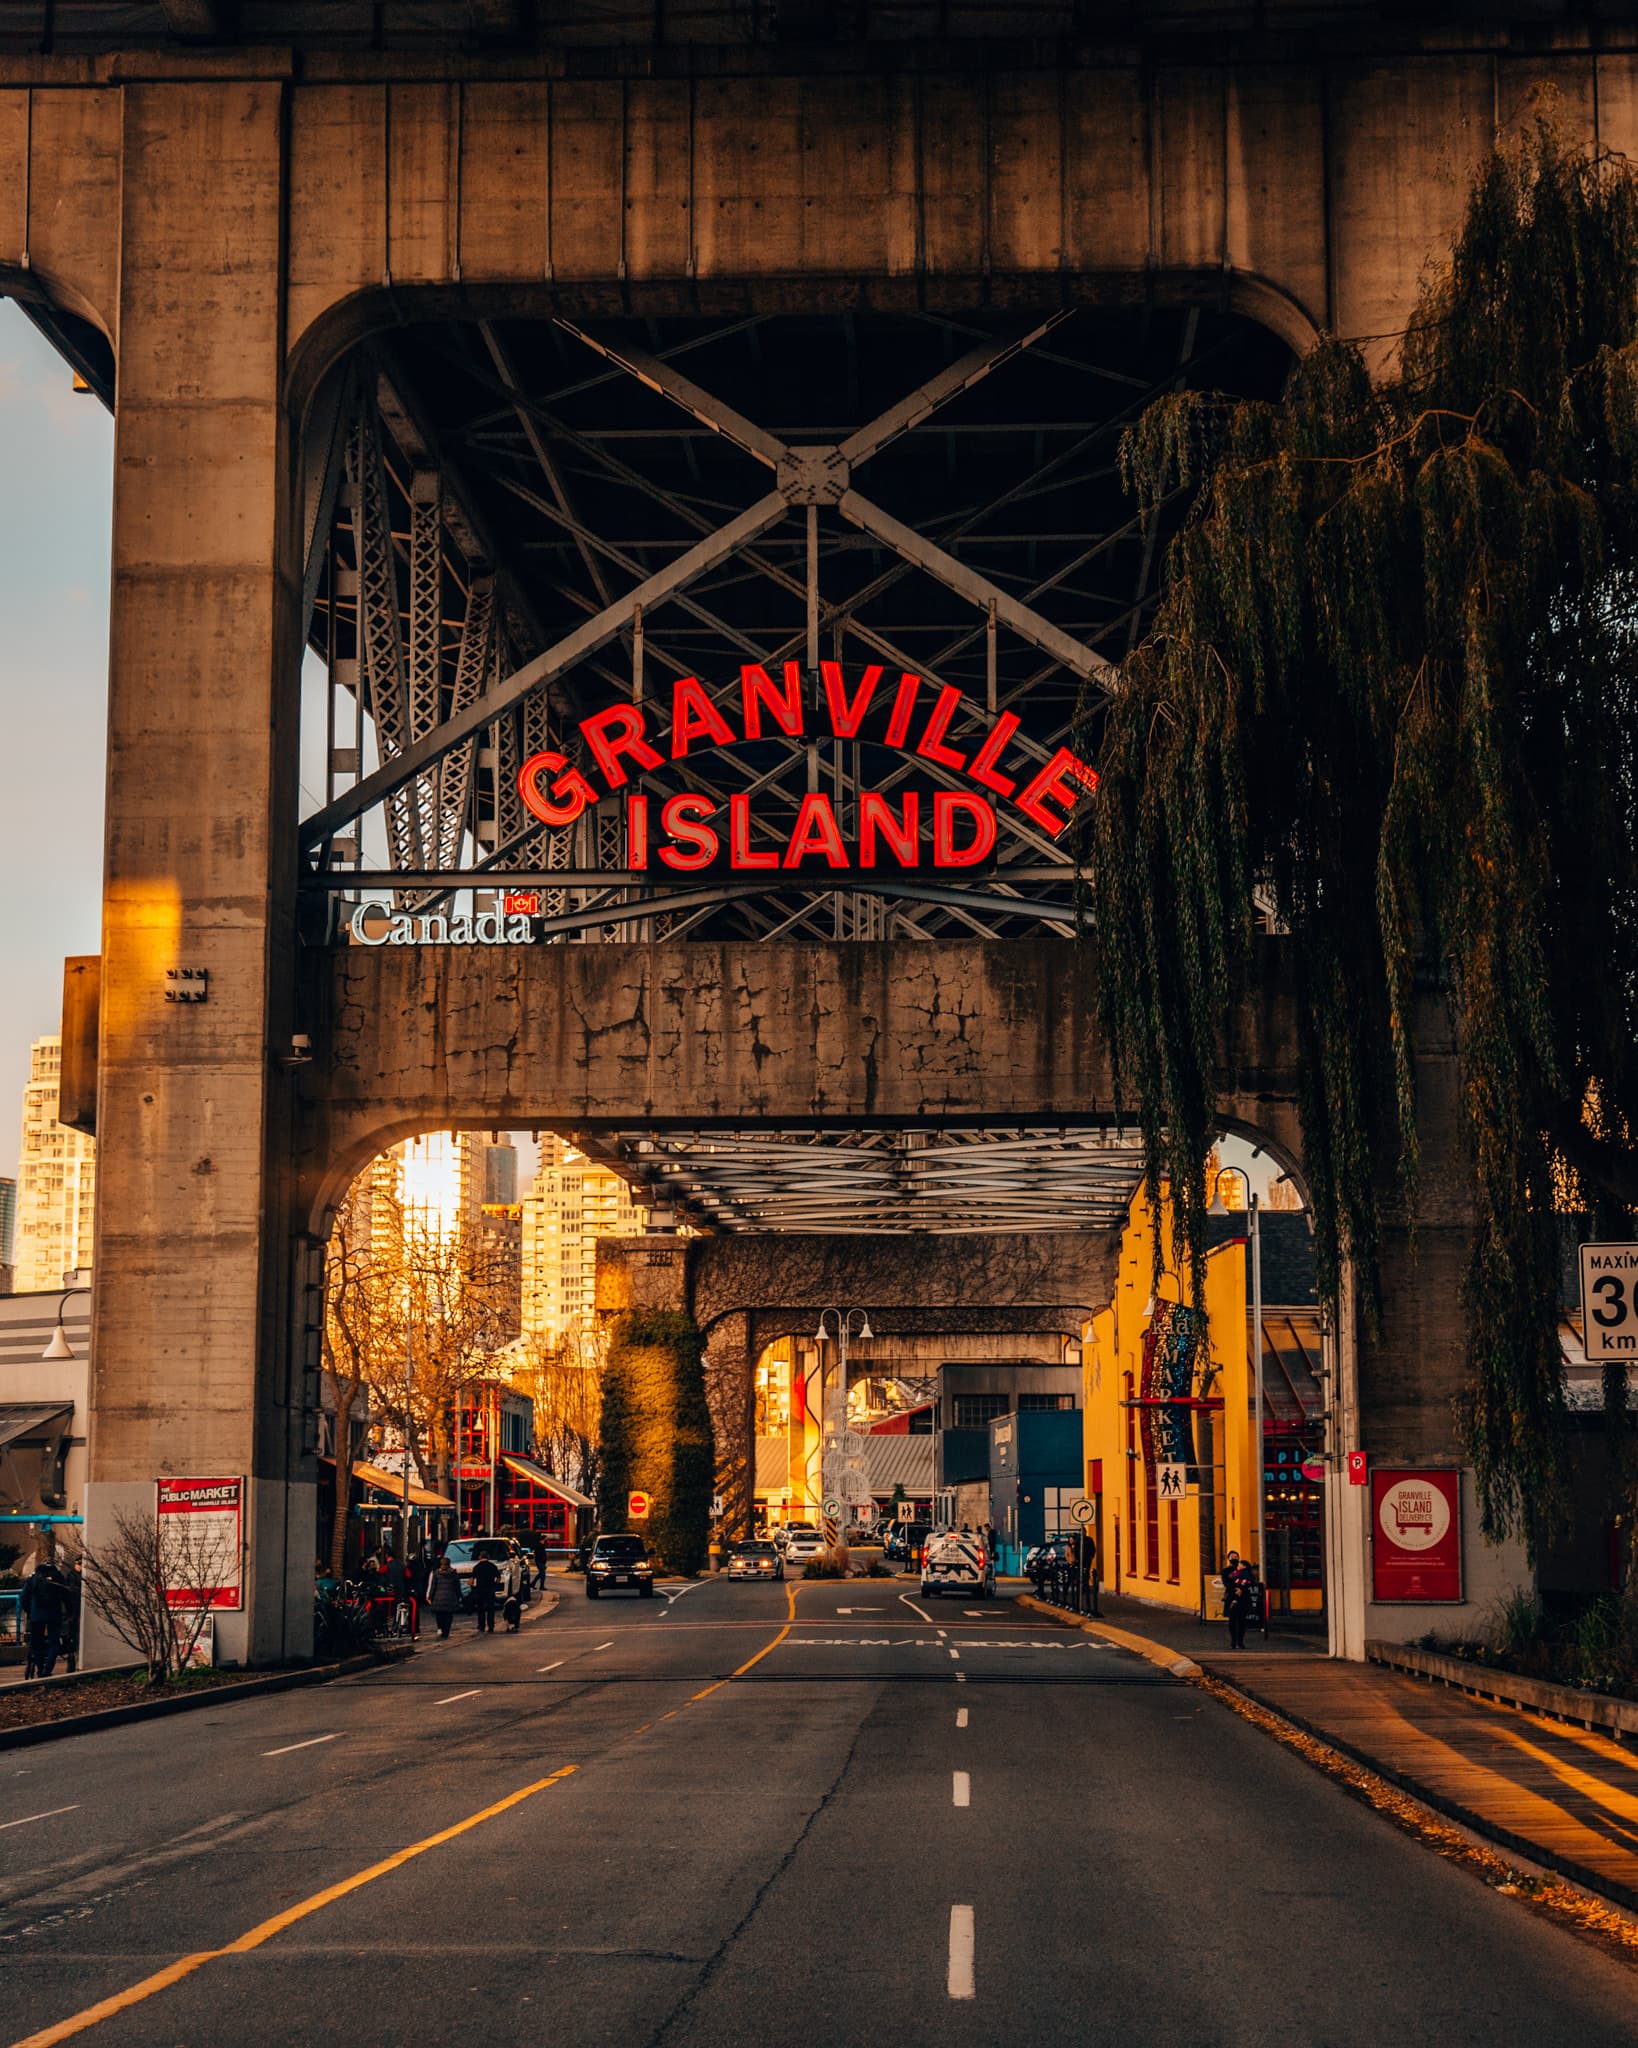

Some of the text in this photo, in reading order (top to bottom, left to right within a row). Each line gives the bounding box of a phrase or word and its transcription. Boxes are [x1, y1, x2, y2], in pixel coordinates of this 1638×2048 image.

[518, 661, 1100, 840] GRANVILLE
[628, 792, 997, 870] ISLAND
[351, 900, 536, 946] Canada
[1591, 1275, 1638, 1327] 3
[1159, 1346, 1179, 1463] MARKET
[161, 1485, 238, 1503] PUBLIC MARKET
[1398, 1491, 1432, 1500] GRANVILLE
[1398, 1500, 1432, 1513] ISLAND
